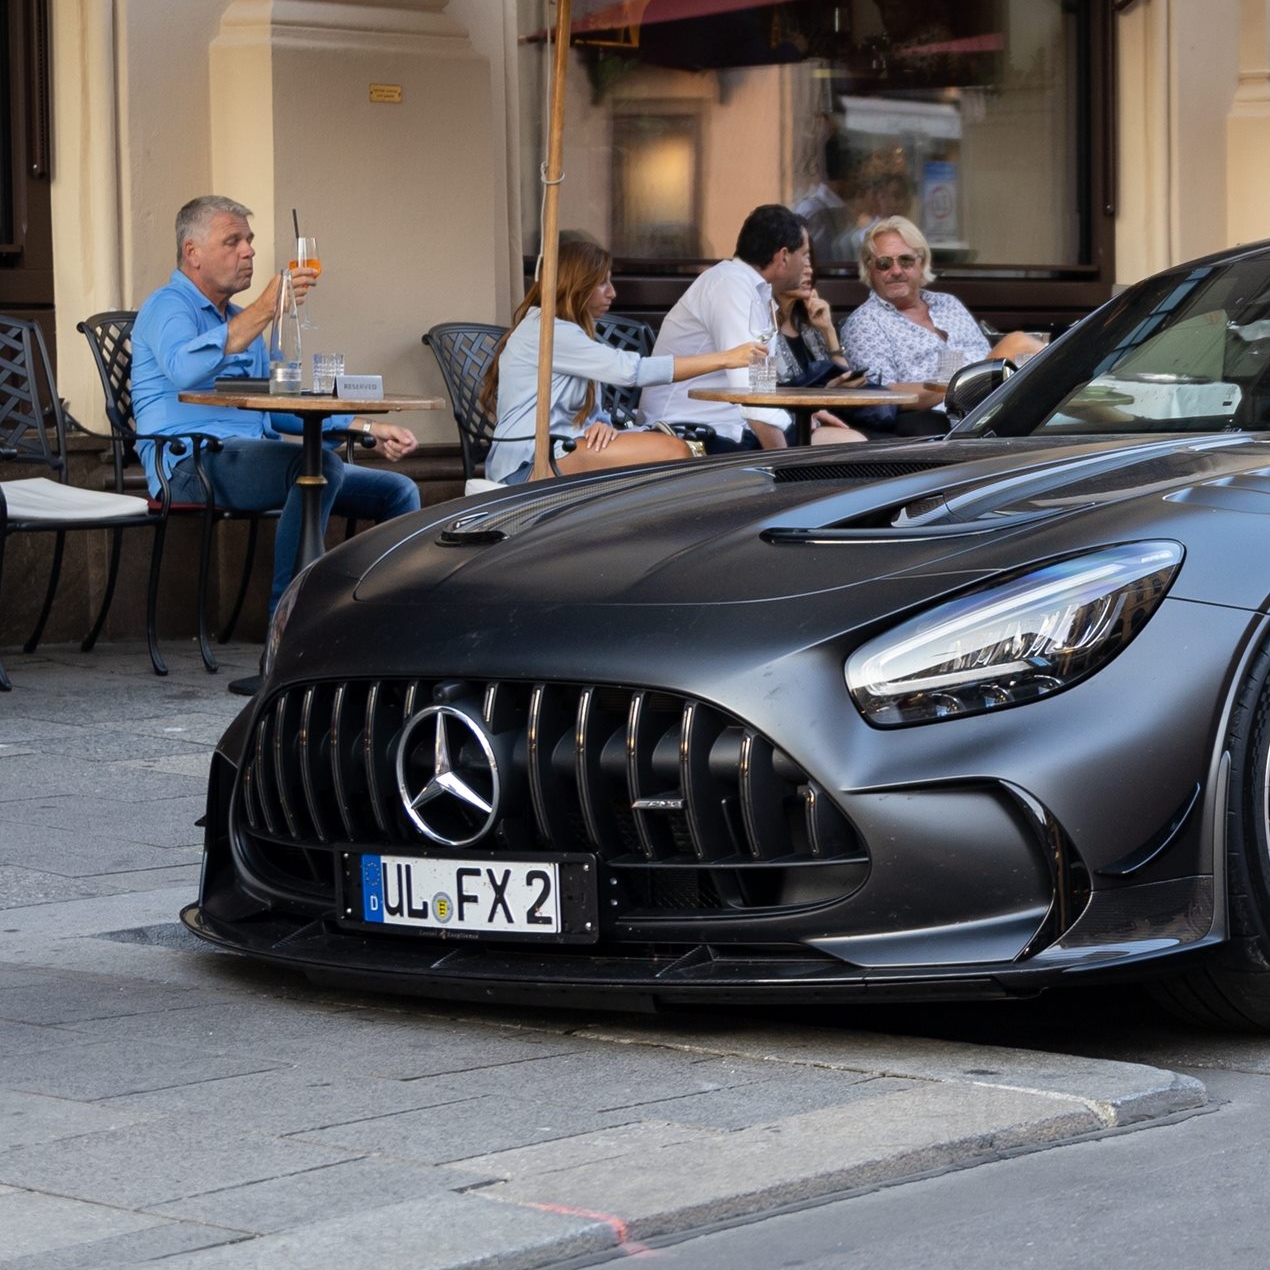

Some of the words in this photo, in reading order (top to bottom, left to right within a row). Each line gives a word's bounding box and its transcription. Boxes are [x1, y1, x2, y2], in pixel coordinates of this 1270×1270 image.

[369, 894, 379, 911] D
[382, 862, 429, 920] UL
[456, 867, 515, 924] FX
[525, 869, 553, 925] 2
